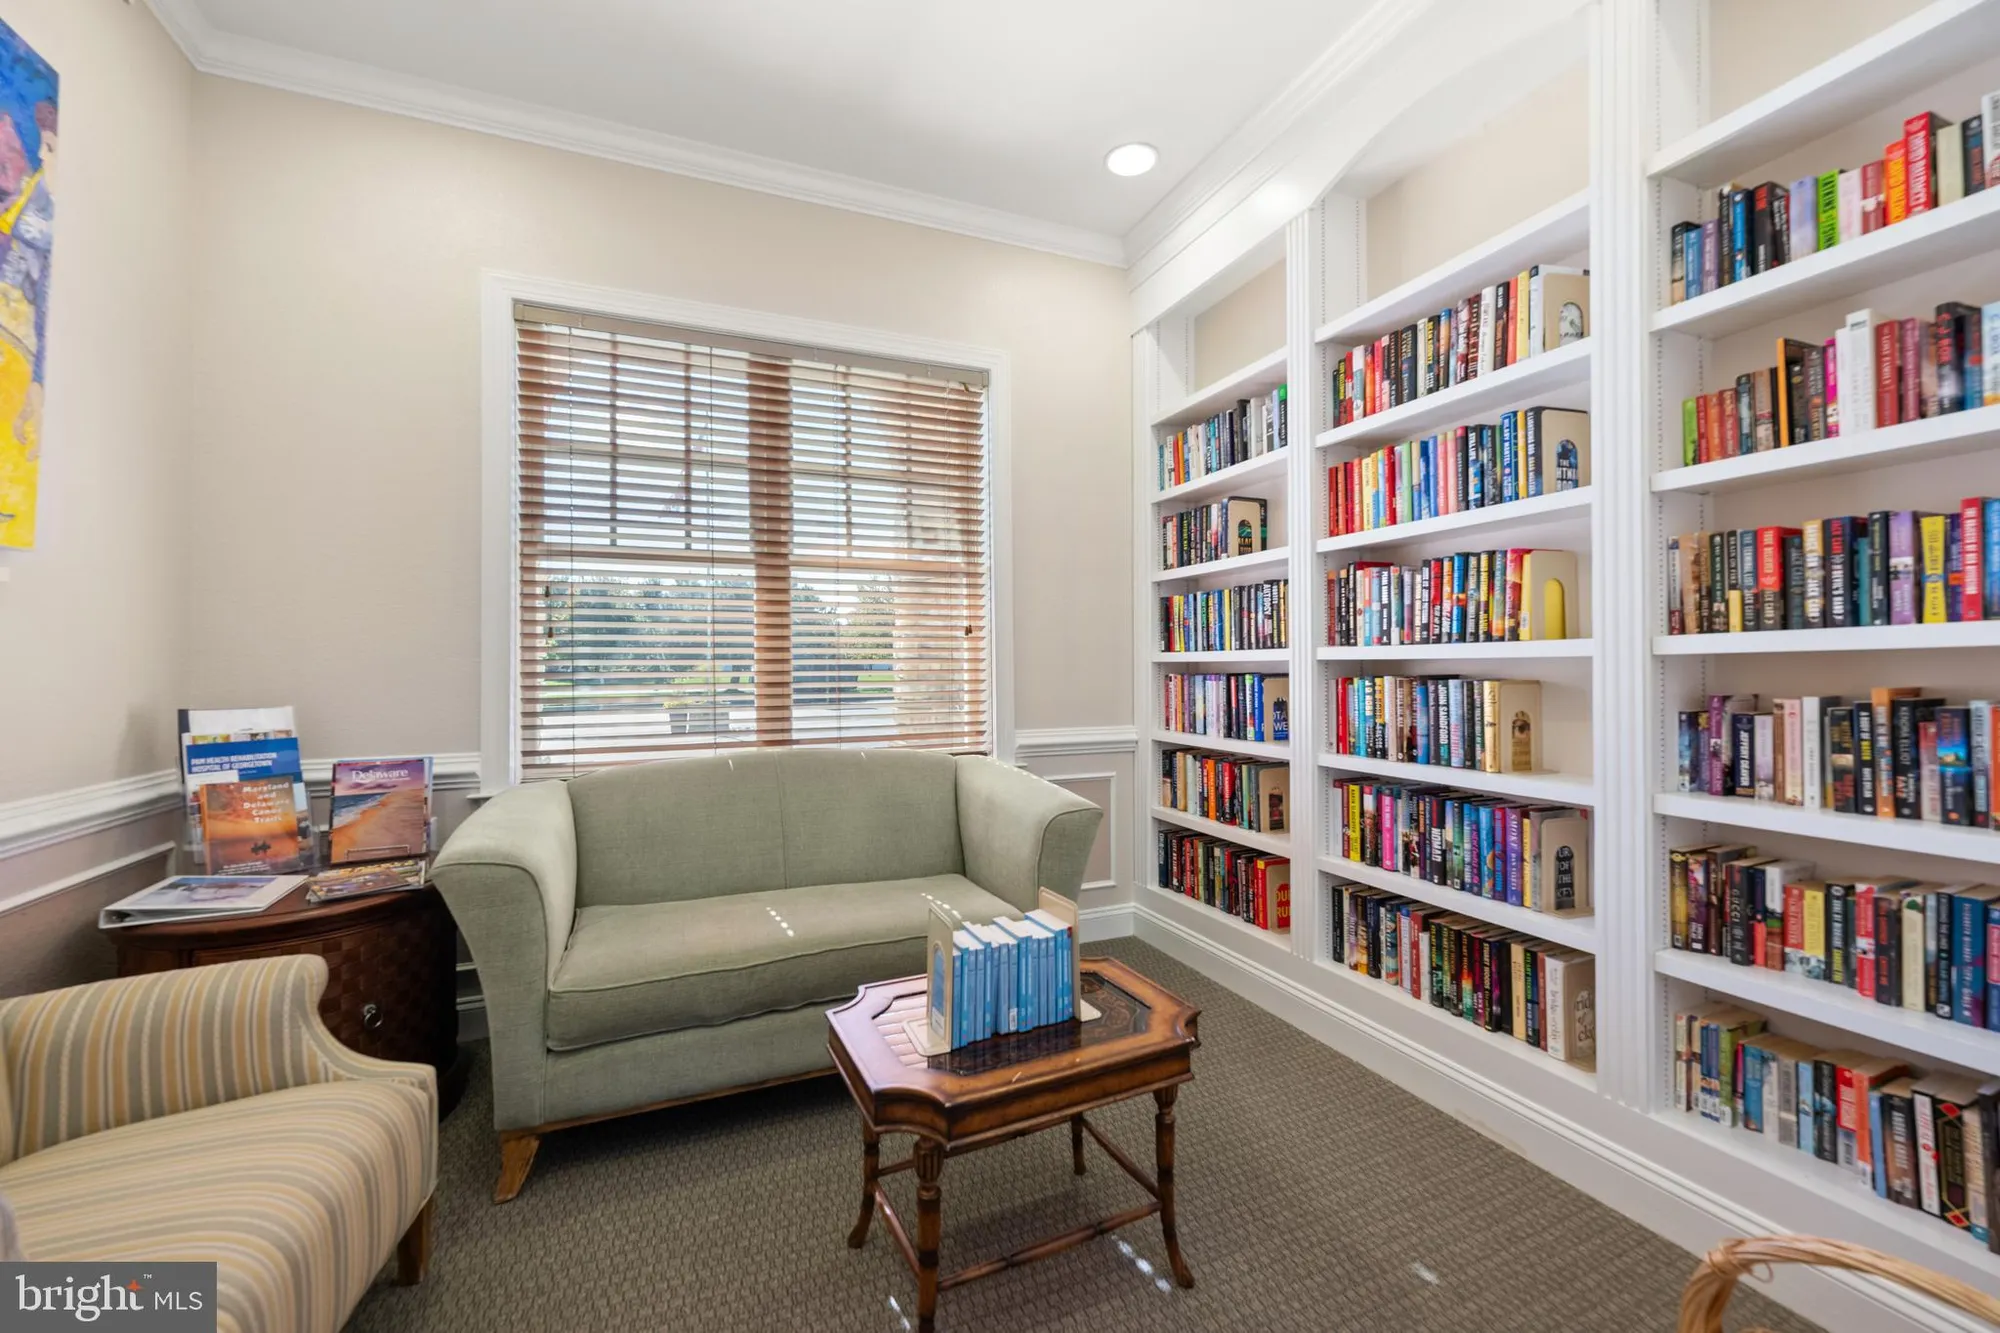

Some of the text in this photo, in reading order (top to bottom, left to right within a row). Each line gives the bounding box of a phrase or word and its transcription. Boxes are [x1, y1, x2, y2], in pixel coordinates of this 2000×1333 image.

[1263, 583, 1271, 615] AUTOPSY
[1438, 685, 1448, 744] JOHN SANDFORD
[352, 769, 408, 783] Delaware
[1739, 731, 1750, 787] JEFFERY DEAVER
[1431, 828, 1442, 862] NOMAD
